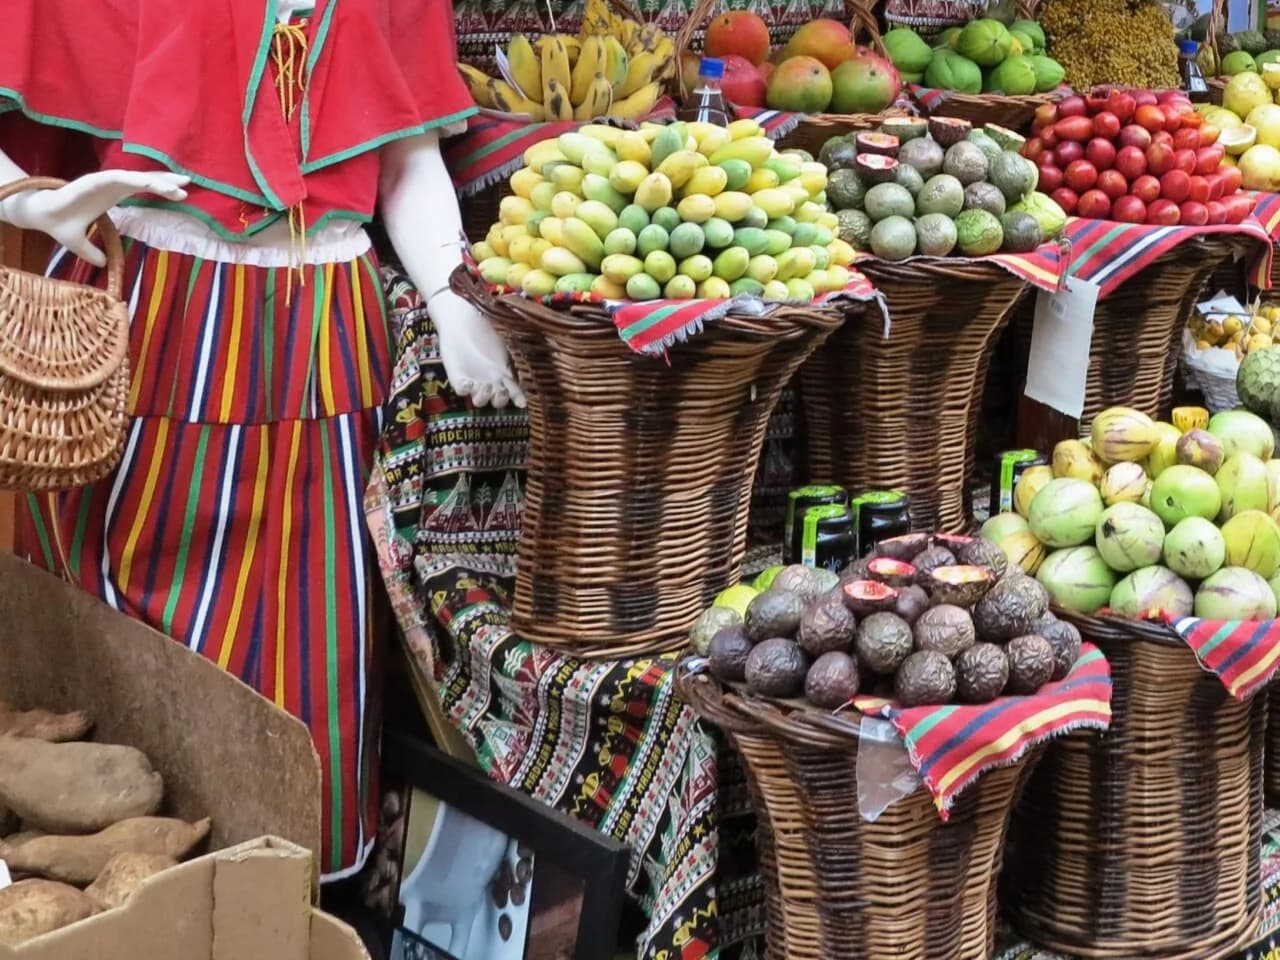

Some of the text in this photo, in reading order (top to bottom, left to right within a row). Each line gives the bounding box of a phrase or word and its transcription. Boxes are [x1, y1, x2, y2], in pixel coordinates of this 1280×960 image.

[431, 427, 481, 444] MADEIRA
[447, 674, 468, 705] EIRA
[523, 743, 553, 790] MADEIRA
[636, 744, 662, 794] MADEIRA
[614, 811, 632, 840] EIRA
